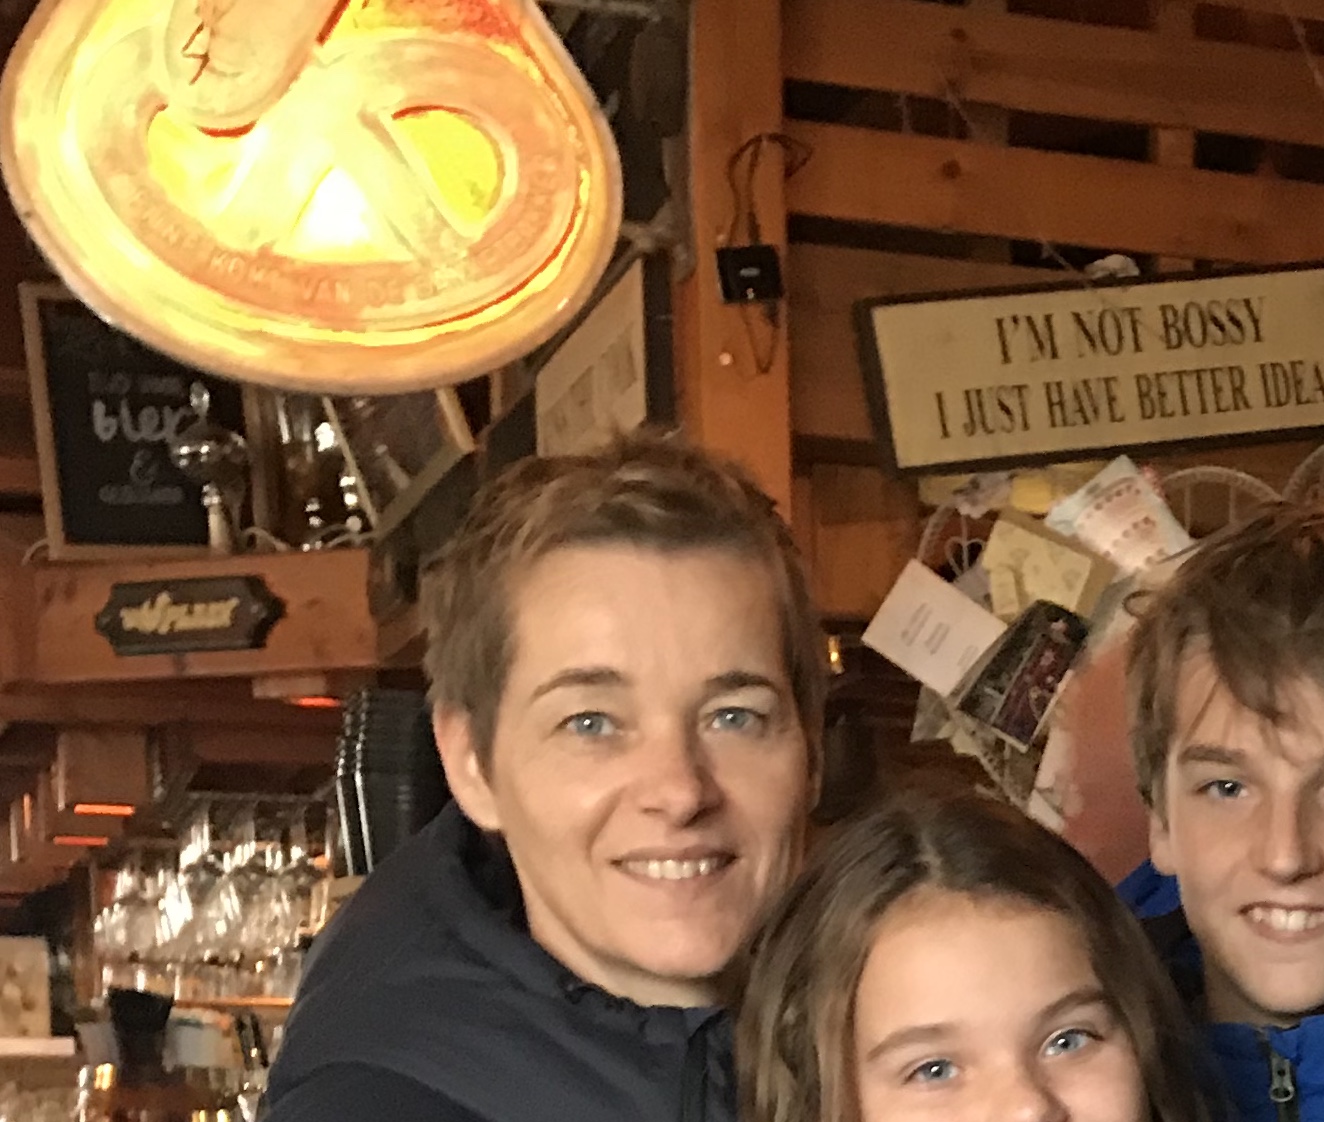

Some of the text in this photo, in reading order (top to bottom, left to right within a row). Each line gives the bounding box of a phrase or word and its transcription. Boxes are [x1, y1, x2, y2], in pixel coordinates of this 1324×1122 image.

[995, 296, 1265, 365] I'M NOT BOSSY
[935, 391, 951, 439] I
[963, 383, 1030, 437] JUST
[1044, 376, 1125, 428] HAVE
[1135, 363, 1253, 420] BETTER
